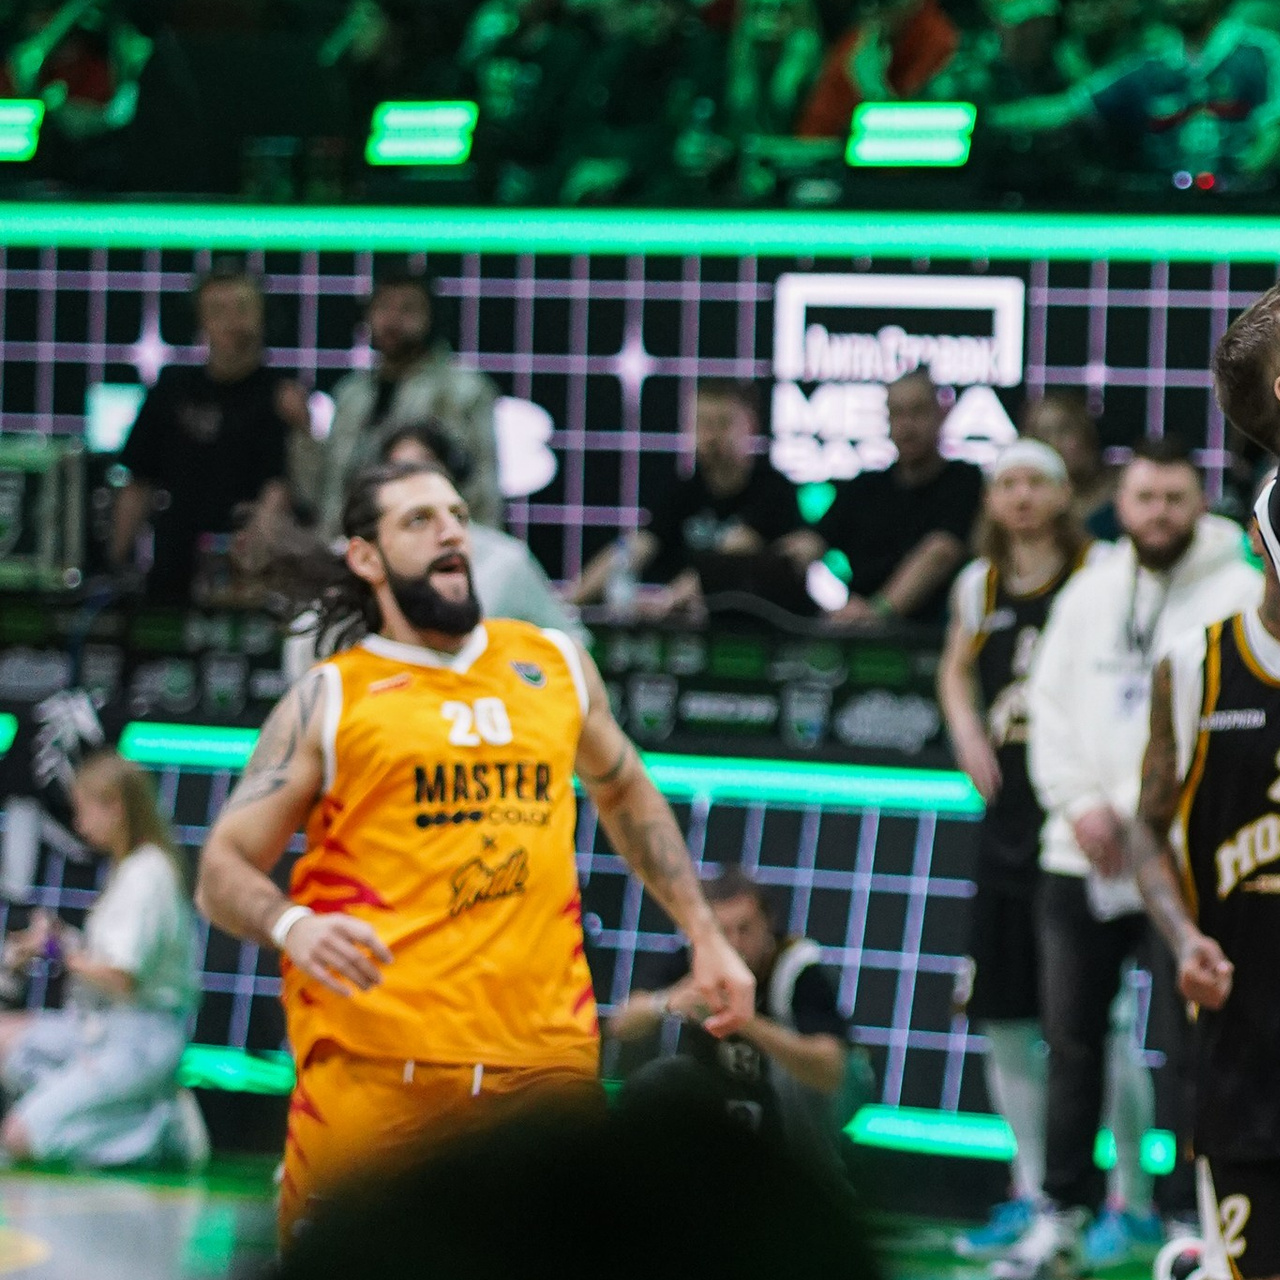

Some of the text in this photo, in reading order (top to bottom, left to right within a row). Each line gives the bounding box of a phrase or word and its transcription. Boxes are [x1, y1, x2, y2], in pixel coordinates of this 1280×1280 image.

[771, 380, 1019, 443] MEA
[441, 696, 512, 746] 20
[415, 763, 550, 803] MASTER
